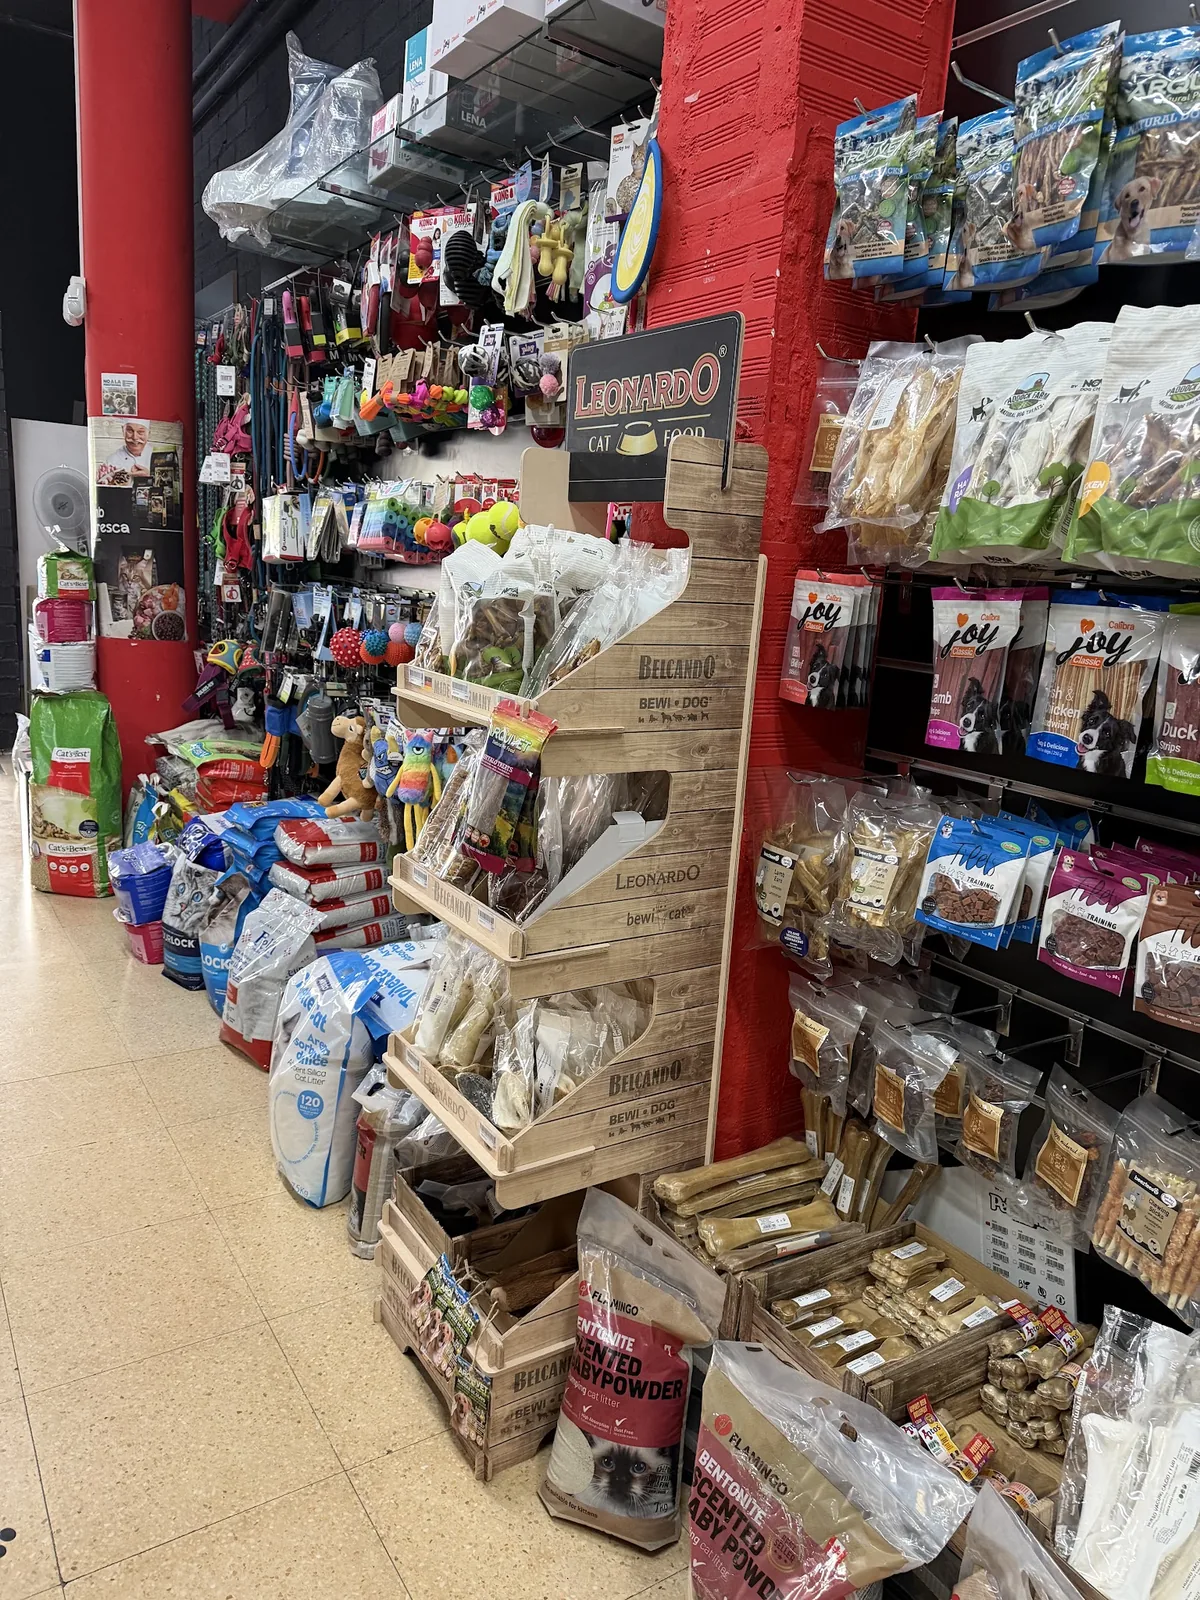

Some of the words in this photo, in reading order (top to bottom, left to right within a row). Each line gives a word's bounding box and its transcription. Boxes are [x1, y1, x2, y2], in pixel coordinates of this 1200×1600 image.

[409, 56, 423, 72] LENA
[461, 110, 487, 129] LENA
[493, 189, 510, 201] KONG
[419, 217, 433, 227] KONG
[454, 213, 471, 224] KONG
[574, 352, 721, 420] LEONARDO
[1004, 393, 1031, 405] PADDOCK
[1031, 391, 1050, 401] FARM
[588, 435, 612, 453] CAT
[825, 594, 842, 602] Calibra
[796, 601, 842, 632] joy
[980, 612, 1001, 622] Calibra
[1108, 620, 1135, 631] Calibra
[805, 622, 824, 631] Classic
[939, 622, 1000, 659] joy
[1055, 630, 1133, 667] joy
[951, 647, 975, 657] Classic
[1072, 655, 1102, 667] Classic
[639, 654, 716, 680] BELCANDO
[639, 697, 671, 709] BEWI
[683, 696, 709, 708] DOG
[1066, 689, 1074, 701] &
[1162, 721, 1199, 742] Duck
[55, 749, 72, 759] Cat's
[1159, 741, 1182, 754] strips
[48, 842, 67, 853] Cat's
[69, 845, 90, 854] Best
[950, 841, 996, 877] Filets
[616, 864, 701, 891] LEONARDO
[966, 876, 995, 891] TRAINING
[434, 880, 471, 924] BELCANDO
[626, 908, 655, 927] bewi
[669, 907, 687, 921] cat
[1086, 913, 1118, 931] TRAINING
[294, 1073, 307, 1082] Cat
[308, 1075, 326, 1086] Litter
[307, 1067, 327, 1078] Silica
[609, 1060, 681, 1097] BELCANDO
[300, 1094, 321, 1107] 120
[423, 1069, 467, 1122] LEONARDO
[609, 1109, 640, 1126] BEWI
[651, 1100, 675, 1115] DOG
[1148, 1198, 1170, 1218] Chewing
[1148, 1206, 1164, 1220] Sticks
[591, 1290, 639, 1317] FLAMINGO
[577, 1315, 636, 1353] ENTONITE
[1025, 1324, 1043, 1338] Antos
[1063, 1335, 1080, 1350] Antos
[587, 1390, 600, 1402] cat
[600, 1393, 621, 1409] litter
[514, 1398, 547, 1420] BEWI
[1070, 1395, 1084, 1436] premium
[614, 1426, 624, 1434] Dust
[921, 1424, 941, 1441] Antos
[729, 1431, 788, 1497] FLAMINGO
[698, 1449, 768, 1526] BENTONITE
[550, 1489, 569, 1507] suitable
[568, 1501, 578, 1511] for
[577, 1505, 599, 1519] kittens
[693, 1466, 766, 1557] SCENTED
[688, 1497, 727, 1542] ABY
[772, 1538, 797, 1563] SELLER
[700, 1541, 713, 1560] cat
[711, 1553, 732, 1580] litter
